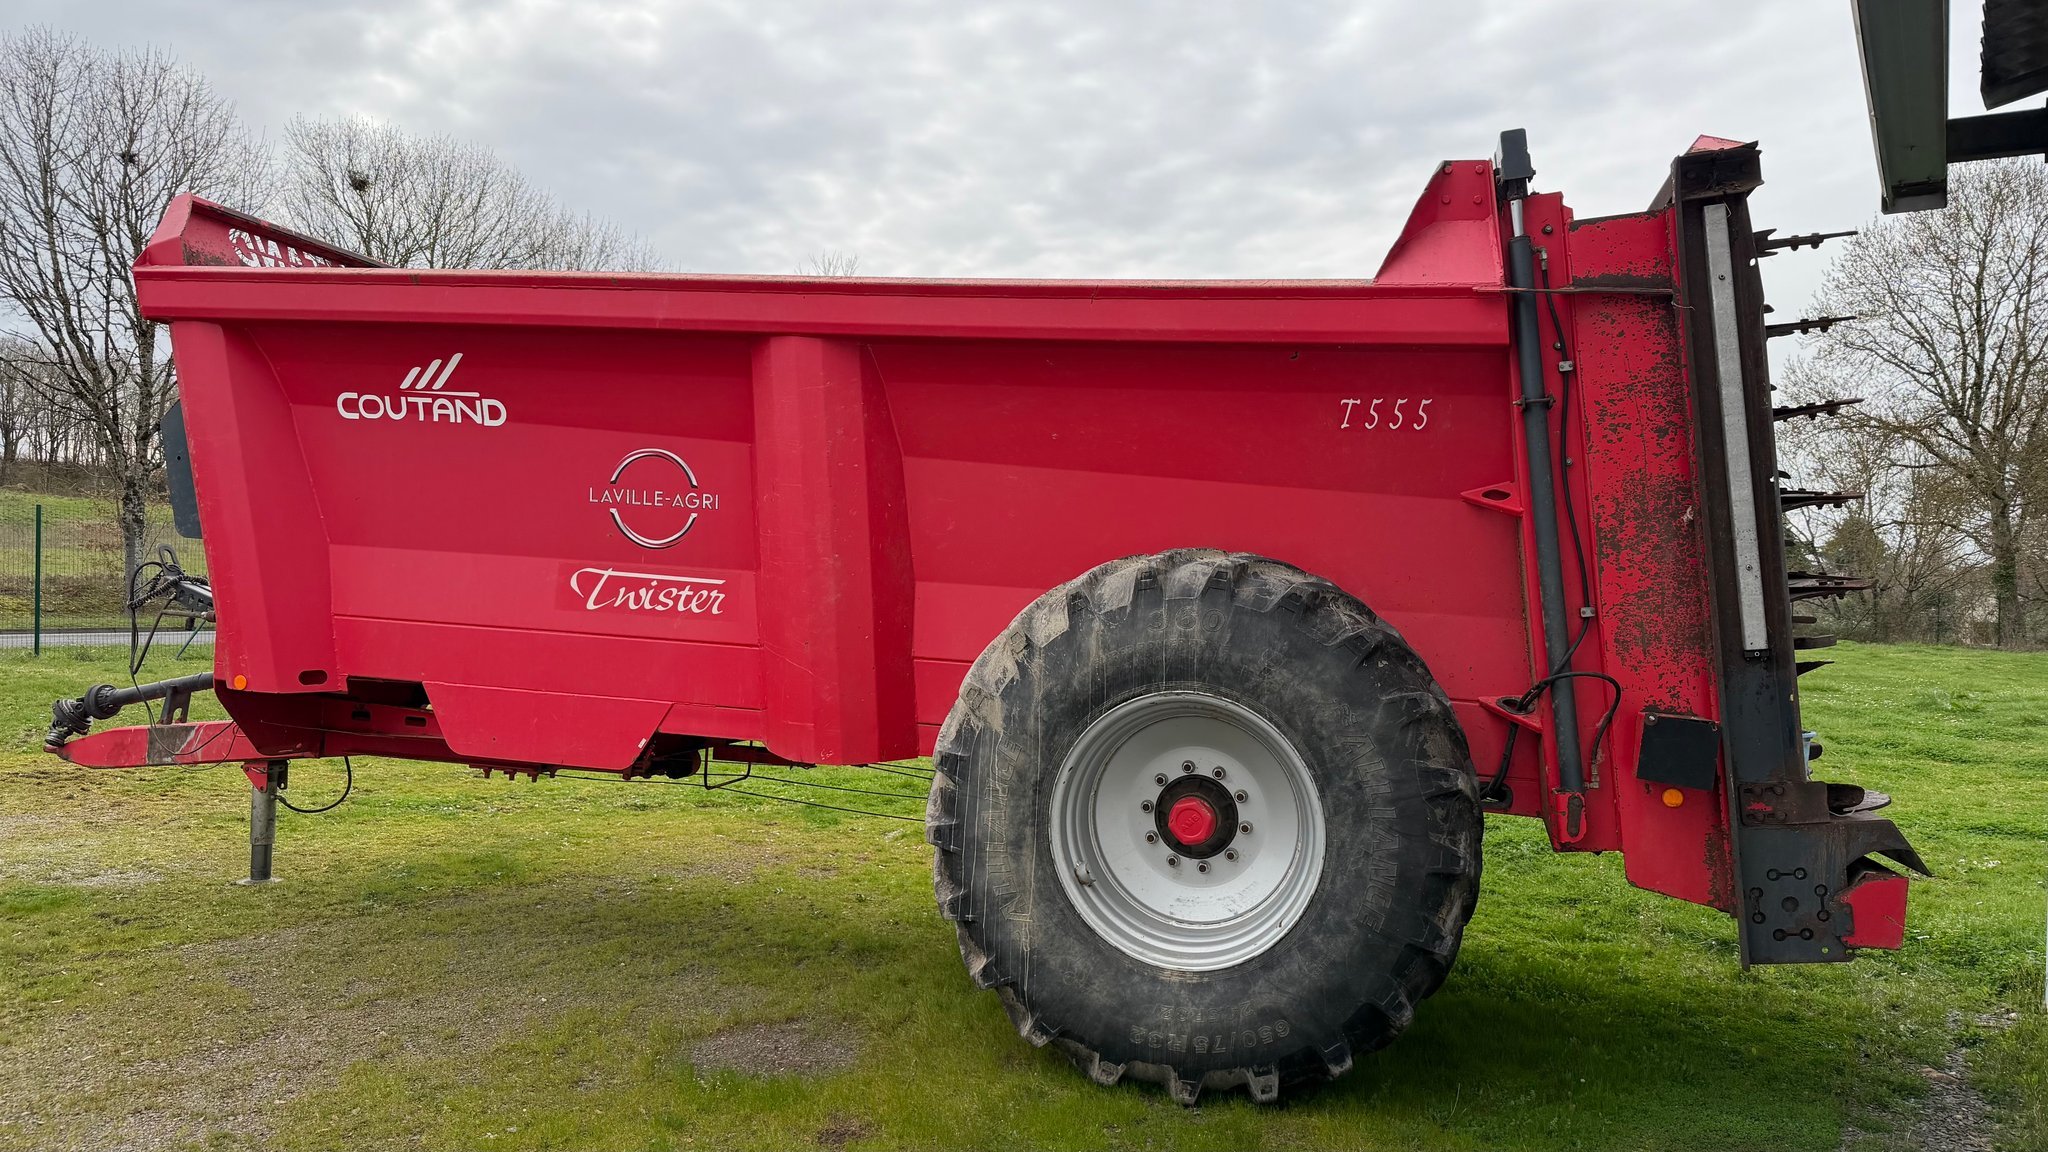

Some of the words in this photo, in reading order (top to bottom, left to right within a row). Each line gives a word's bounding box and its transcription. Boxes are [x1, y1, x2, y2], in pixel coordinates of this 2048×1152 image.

[336, 391, 508, 427] COUTAND
[588, 487, 720, 510] LAVILLE-AGRI
[570, 567, 727, 615] Twister
[1146, 606, 1226, 634] 360
[983, 731, 1033, 923] ALLIANCE
[1336, 732, 1400, 935] ALLIANCE
